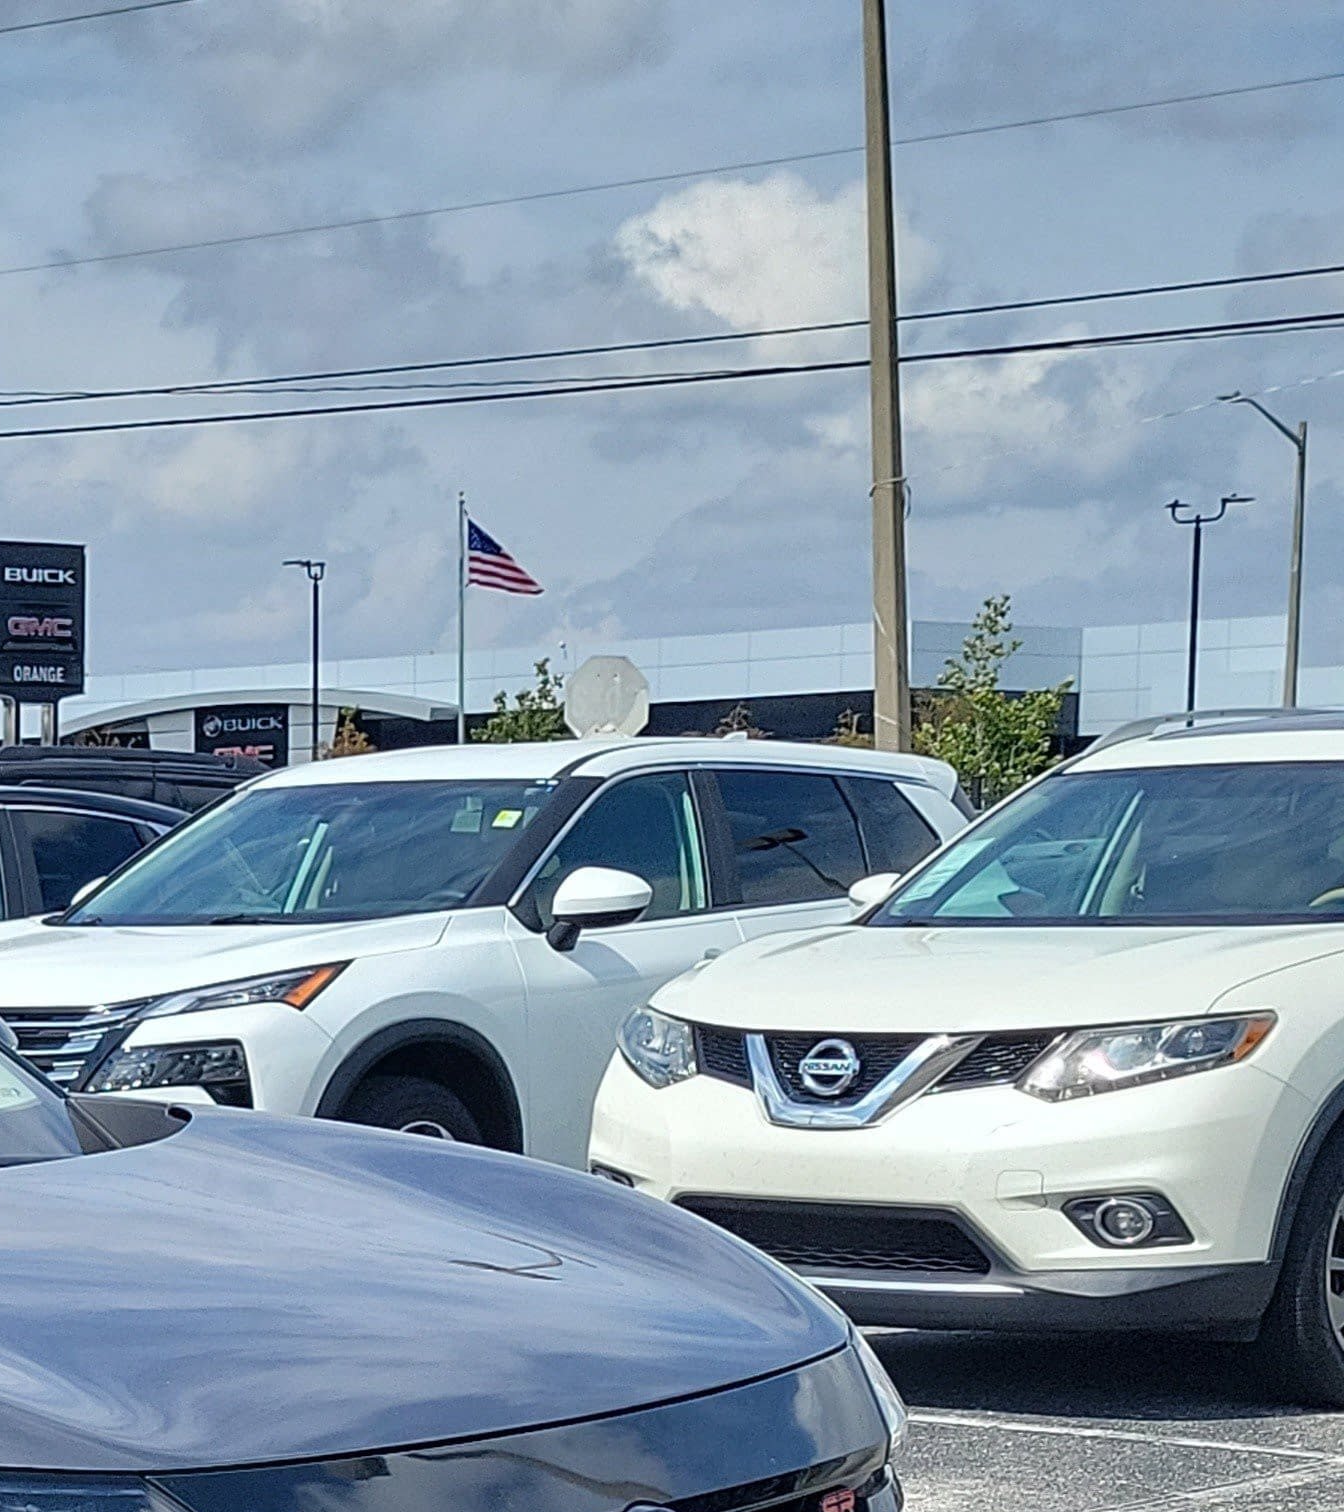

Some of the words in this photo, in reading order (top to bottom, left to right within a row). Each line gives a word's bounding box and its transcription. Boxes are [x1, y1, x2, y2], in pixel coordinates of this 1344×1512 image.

[4, 566, 76, 585] BUICK
[7, 616, 73, 637] GMC
[13, 665, 65, 683] ORANGE
[223, 716, 283, 732] BUICK
[803, 1061, 853, 1073] NISSAN
